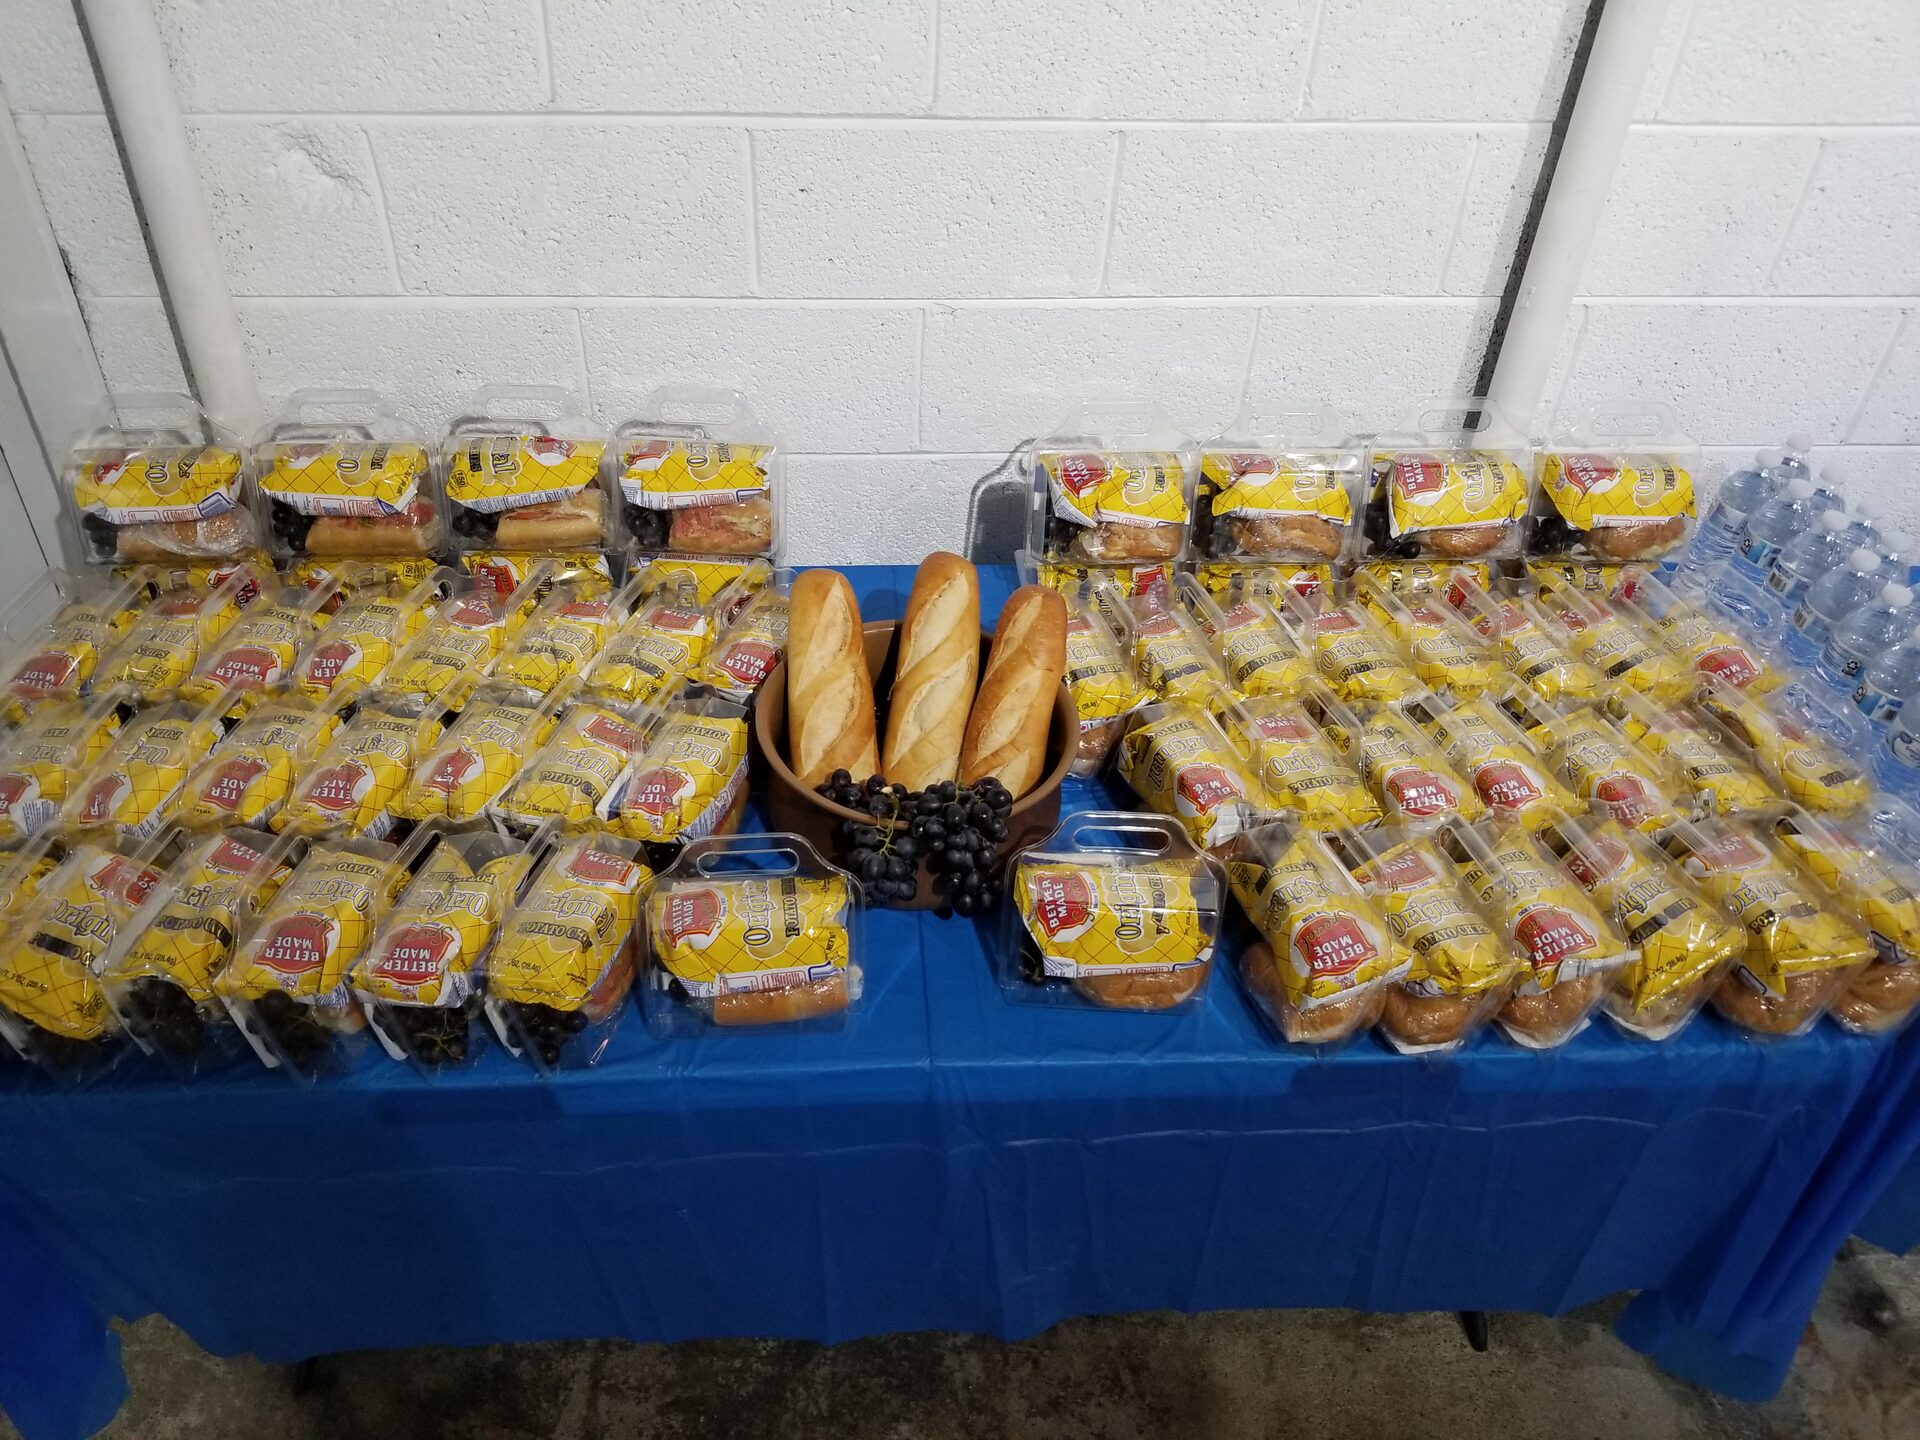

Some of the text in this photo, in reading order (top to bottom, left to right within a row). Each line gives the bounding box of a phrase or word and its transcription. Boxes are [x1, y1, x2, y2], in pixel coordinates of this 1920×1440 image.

[456, 470, 468, 488] 150
[1065, 457, 1085, 488] ETTER
[1076, 457, 1092, 481] ADE
[1411, 456, 1425, 483] MADE
[1459, 457, 1485, 501] Orig
[1568, 455, 1594, 489] BETTER
[1579, 456, 1600, 490] MADE
[404, 563, 415, 579] 150
[349, 616, 393, 638] Orig
[319, 657, 345, 669] ADE
[432, 654, 466, 671] CHIPS
[734, 652, 767, 670] MADE
[1319, 638, 1378, 671] Origin
[151, 664, 169, 676] 150
[224, 660, 261, 673] MADE
[313, 667, 342, 678] TER
[725, 658, 766, 681] BETTER
[1338, 660, 1376, 683] POTATO
[474, 719, 525, 748] Orig
[1462, 718, 1487, 728] POT
[686, 725, 731, 744] POTATO
[674, 738, 722, 768] Orig
[1148, 735, 1211, 788] riginal
[210, 786, 238, 801] TER
[220, 777, 249, 790] ADE
[310, 786, 353, 800] ETTER
[1288, 775, 1333, 796] POTATO
[1403, 784, 1437, 799] MAE
[1486, 777, 1520, 796] MADE
[637, 792, 669, 806] TER
[1491, 788, 1530, 804] BETTE
[1386, 861, 1414, 873] ADE
[1390, 853, 1416, 867] TTER
[1042, 879, 1060, 929] BETTER
[1051, 881, 1068, 919] MADE
[530, 891, 615, 939] riginal
[671, 897, 683, 936] BETTER
[683, 898, 695, 927] MADE
[782, 896, 800, 938] POTATO
[1389, 896, 1464, 938] Origin
[516, 921, 566, 938] POTATO
[1535, 925, 1572, 949] MADE
[275, 935, 314, 950] MADE
[826, 938, 836, 952] NET
[1314, 934, 1354, 957] MADE
[1413, 926, 1455, 956] POTATO
[1534, 933, 1585, 961] BETTER
[263, 946, 321, 962] BETTER
[392, 947, 431, 960] MADE
[1313, 943, 1366, 970] BETTER
[384, 959, 437, 973] BETTER
